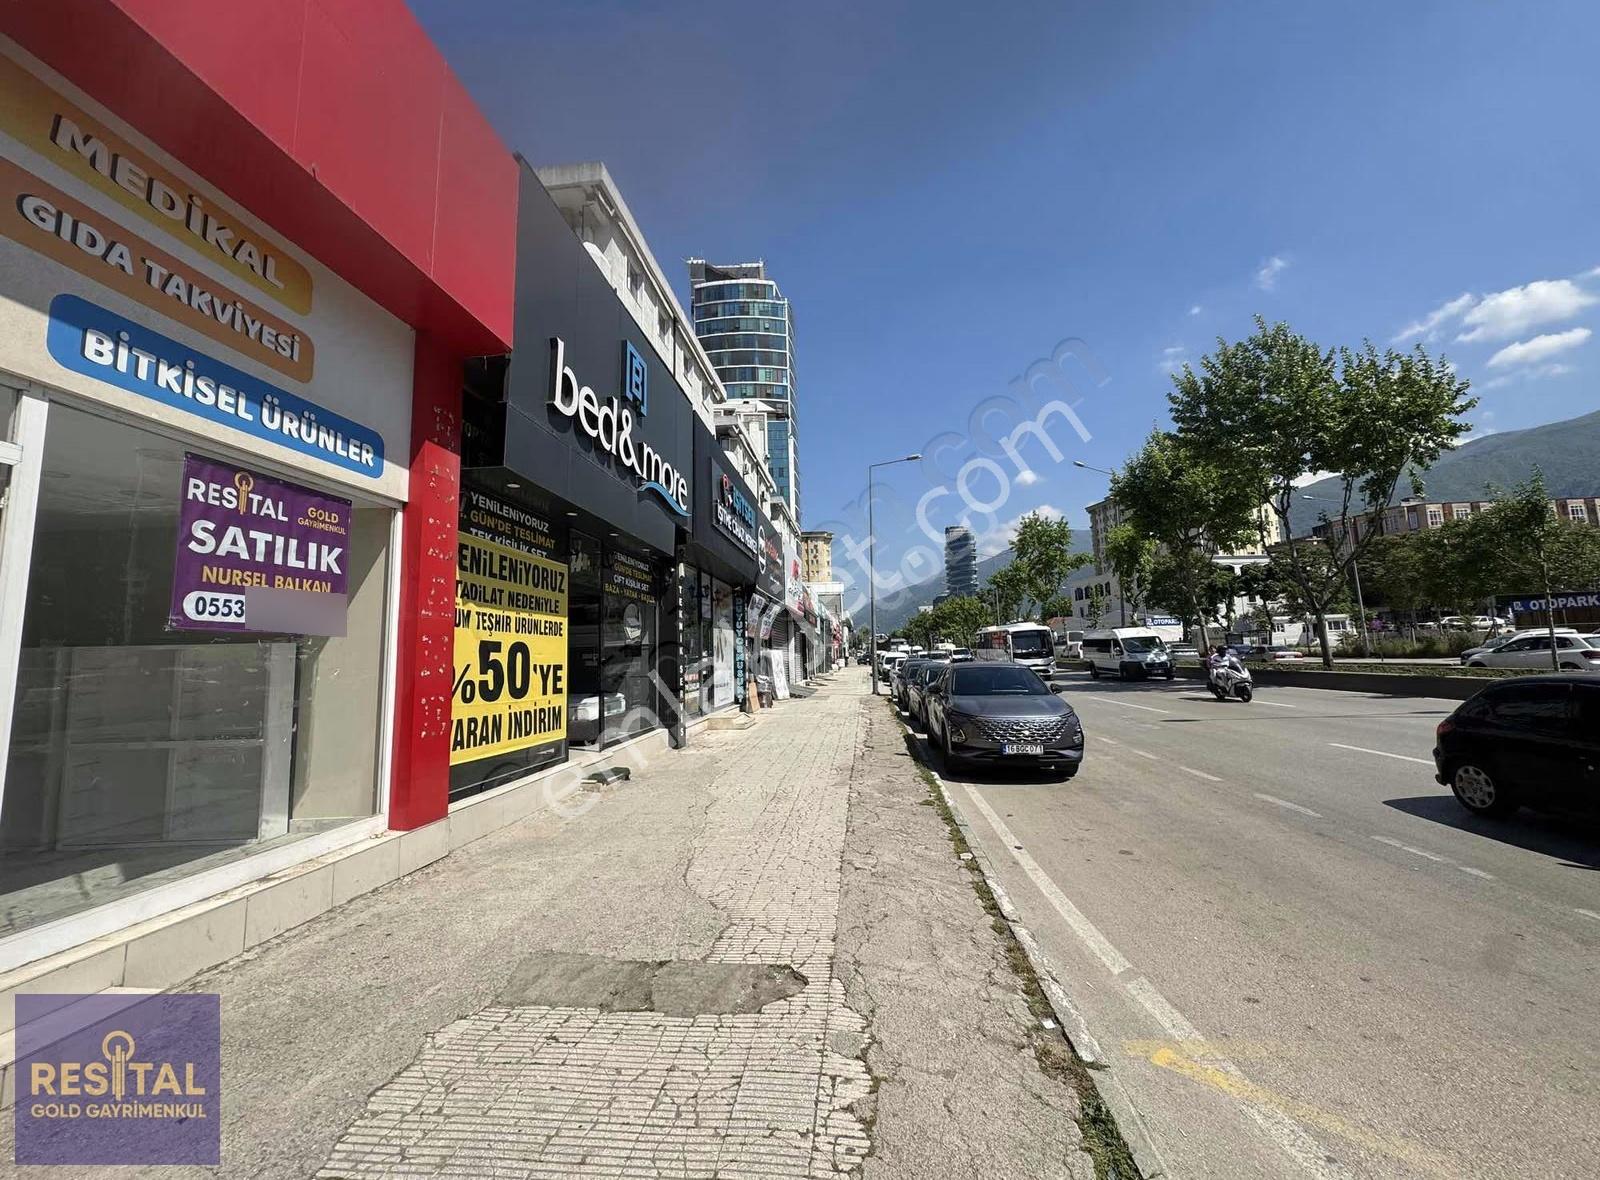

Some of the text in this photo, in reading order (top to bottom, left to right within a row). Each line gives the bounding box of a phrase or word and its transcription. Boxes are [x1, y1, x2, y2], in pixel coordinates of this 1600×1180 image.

[51, 113, 285, 290] MEDİKAL
[17, 193, 300, 363] GIDA TAKVİYESİ
[82, 327, 375, 467] BİTKİSEL ÜRÜNLER
[308, 507, 339, 523] GOLD
[470, 491, 550, 533] YENİLENİYORUZ
[188, 519, 343, 575] SATILIK
[458, 542, 566, 594] ENİLENİYORUZ
[202, 565, 332, 593] NURSEL BALKAN
[194, 596, 246, 618] 0553
[508, 590, 560, 614] NEDENİYLE
[1529, 595, 1600, 610] OTOPARK
[475, 610, 512, 637] TEŞHİR
[514, 611, 564, 637] ÜRÜNLERDE
[451, 700, 563, 752] ARAN İNDİRİM
